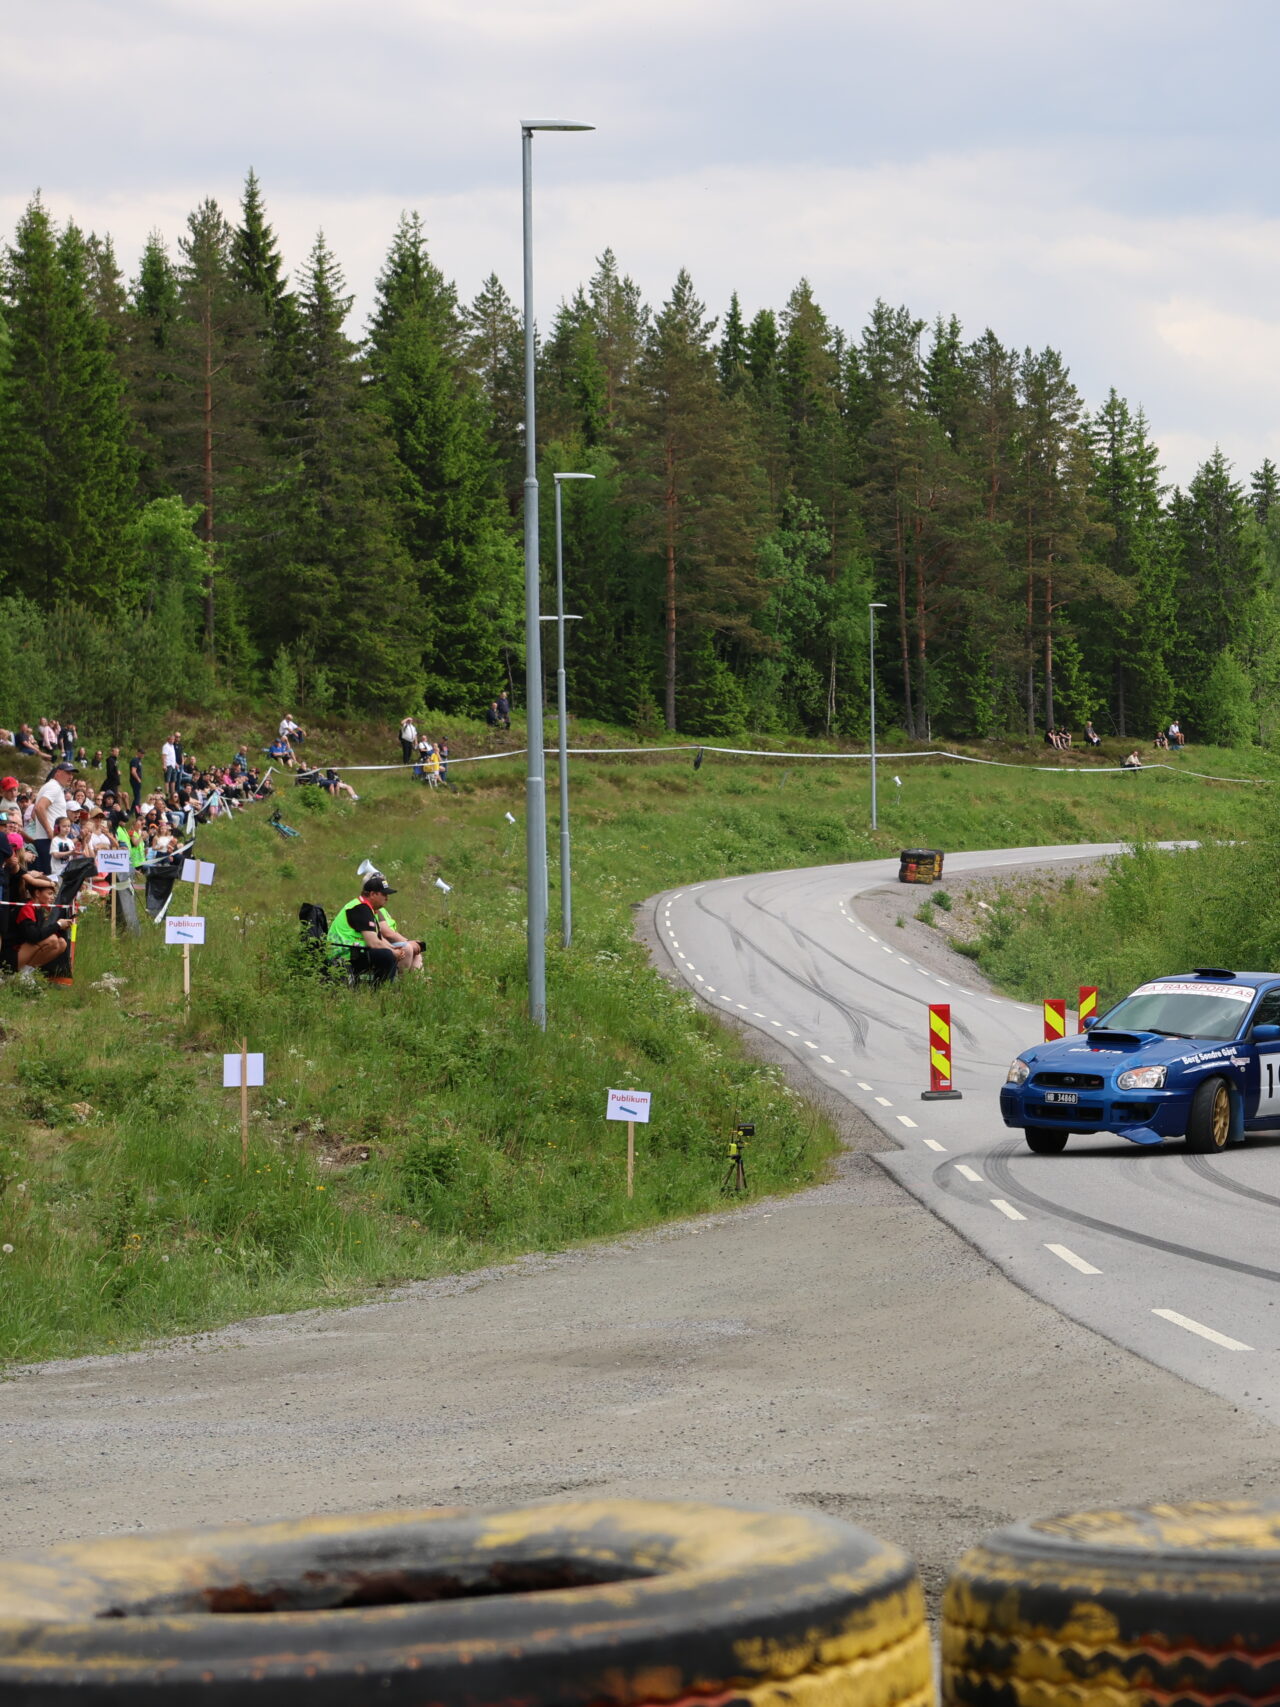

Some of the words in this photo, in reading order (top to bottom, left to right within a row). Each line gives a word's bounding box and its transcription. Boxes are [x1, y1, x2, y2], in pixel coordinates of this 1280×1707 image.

[168, 920, 203, 928] Publikum
[1181, 1055, 1201, 1065] Berg
[611, 1094, 648, 1104] Publikum
